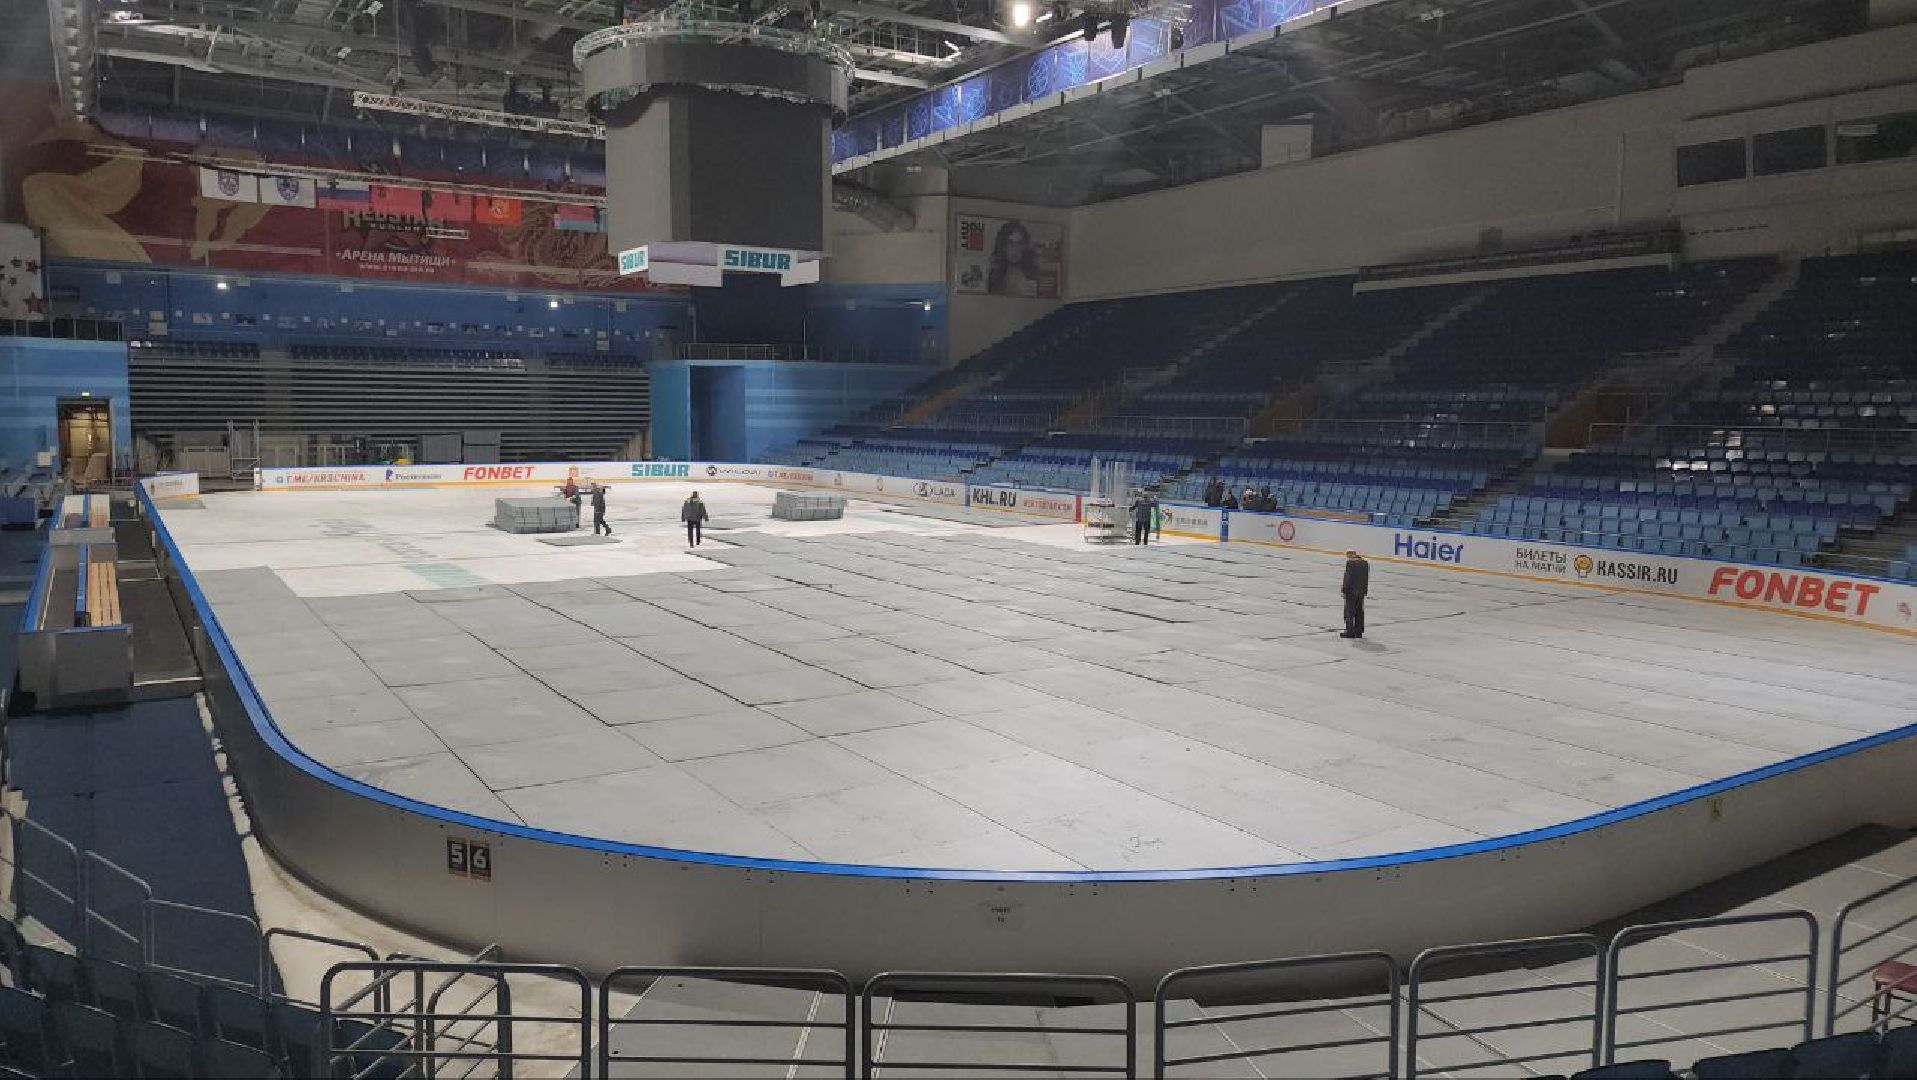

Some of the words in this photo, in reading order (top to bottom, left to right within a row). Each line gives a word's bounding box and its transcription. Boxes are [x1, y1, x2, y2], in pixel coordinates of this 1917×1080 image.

[725, 249, 791, 270] SIBUR
[463, 465, 535, 480] FONBET
[631, 463, 690, 477] SIBUR
[972, 487, 1017, 507] KHL.RU
[1394, 532, 1465, 563] Haier
[1515, 547, 1567, 563] БИЛЕТЫ
[1515, 560, 1530, 571] НА
[1531, 562, 1567, 575] МАТЧИ
[1597, 560, 1678, 585] KASSIR.RU
[1707, 566, 1881, 615] FONBET
